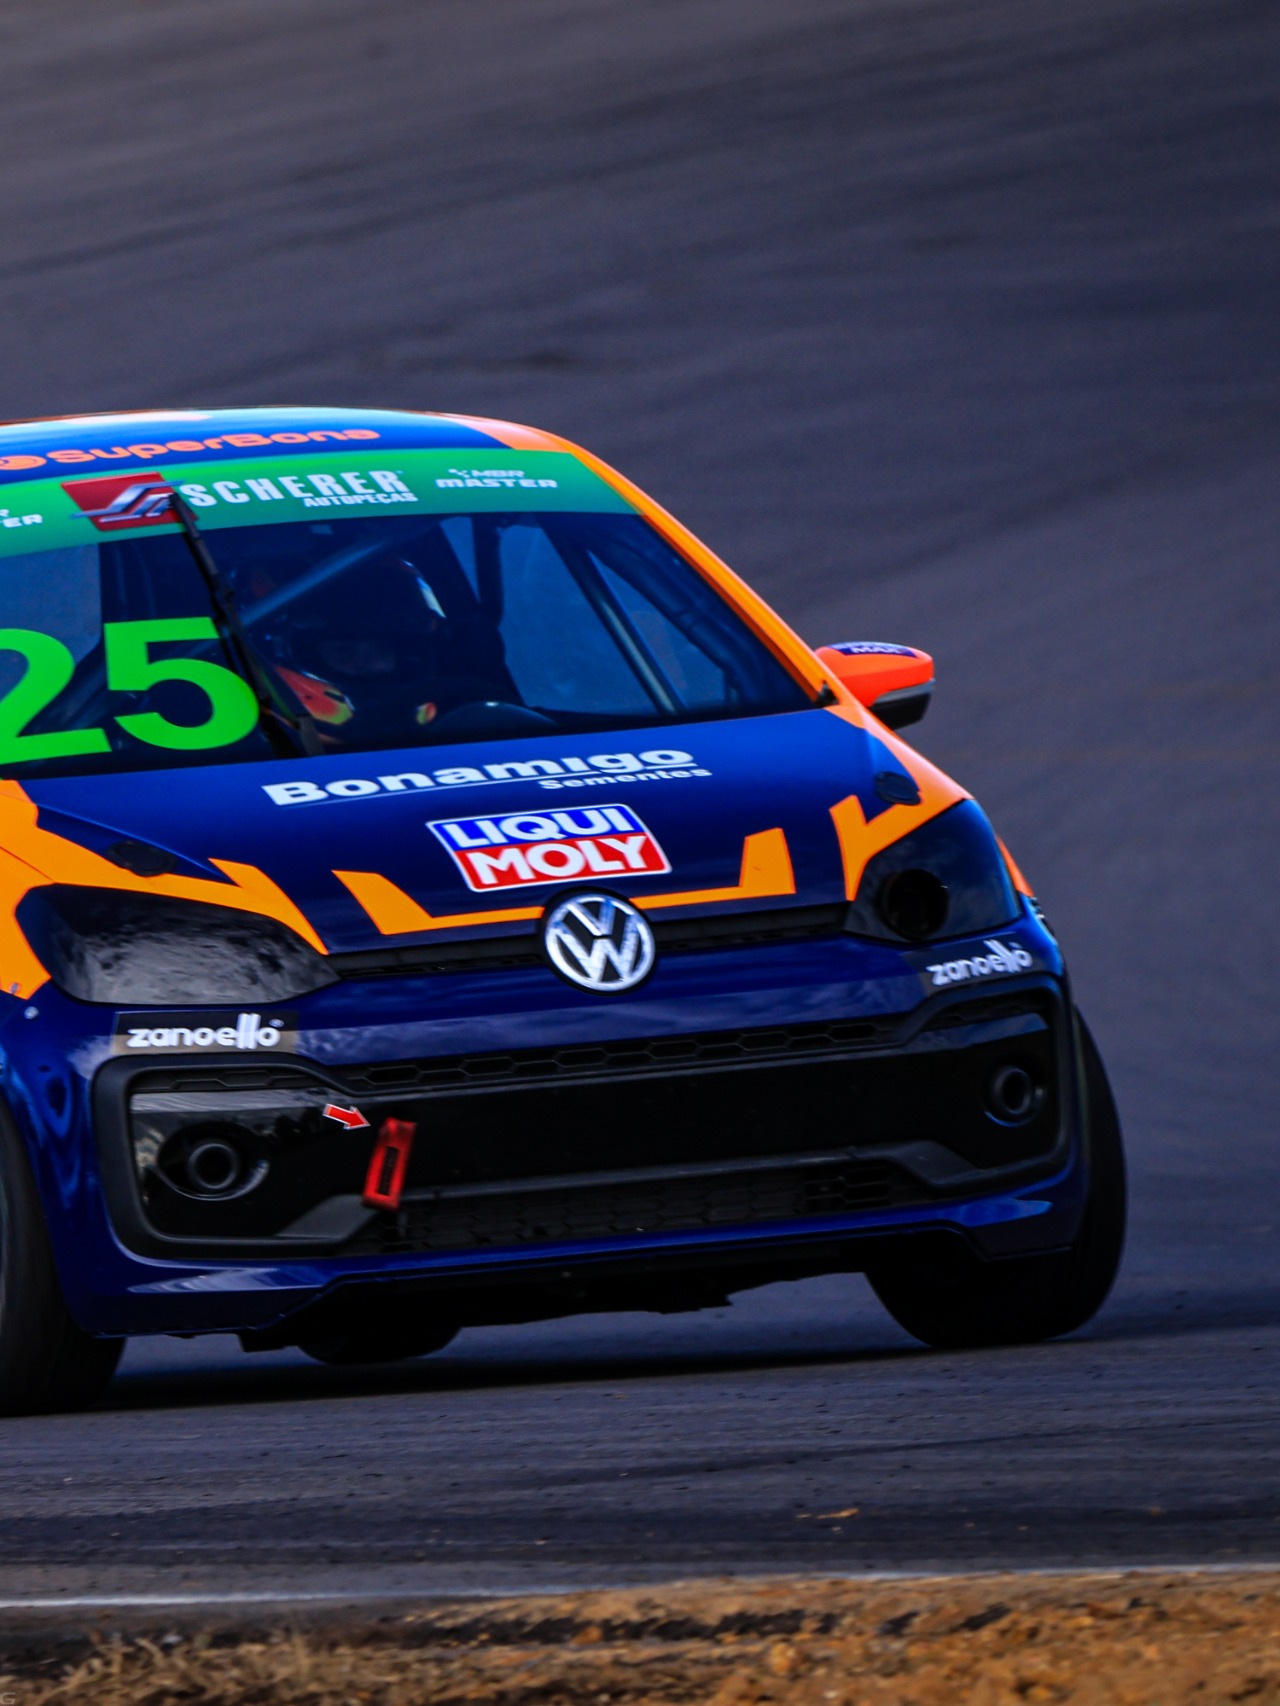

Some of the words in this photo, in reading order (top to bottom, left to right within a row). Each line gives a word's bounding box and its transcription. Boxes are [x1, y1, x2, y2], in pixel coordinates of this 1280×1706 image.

[179, 470, 410, 507] SCHERER
[435, 478, 558, 489] MASTER
[261, 749, 695, 806] Bonamigo
[540, 766, 713, 790] Sementes
[442, 807, 635, 849] LIQUI
[466, 834, 648, 885] MOLY
[926, 939, 1033, 986] zanoello
[126, 1012, 281, 1050] zanoello
